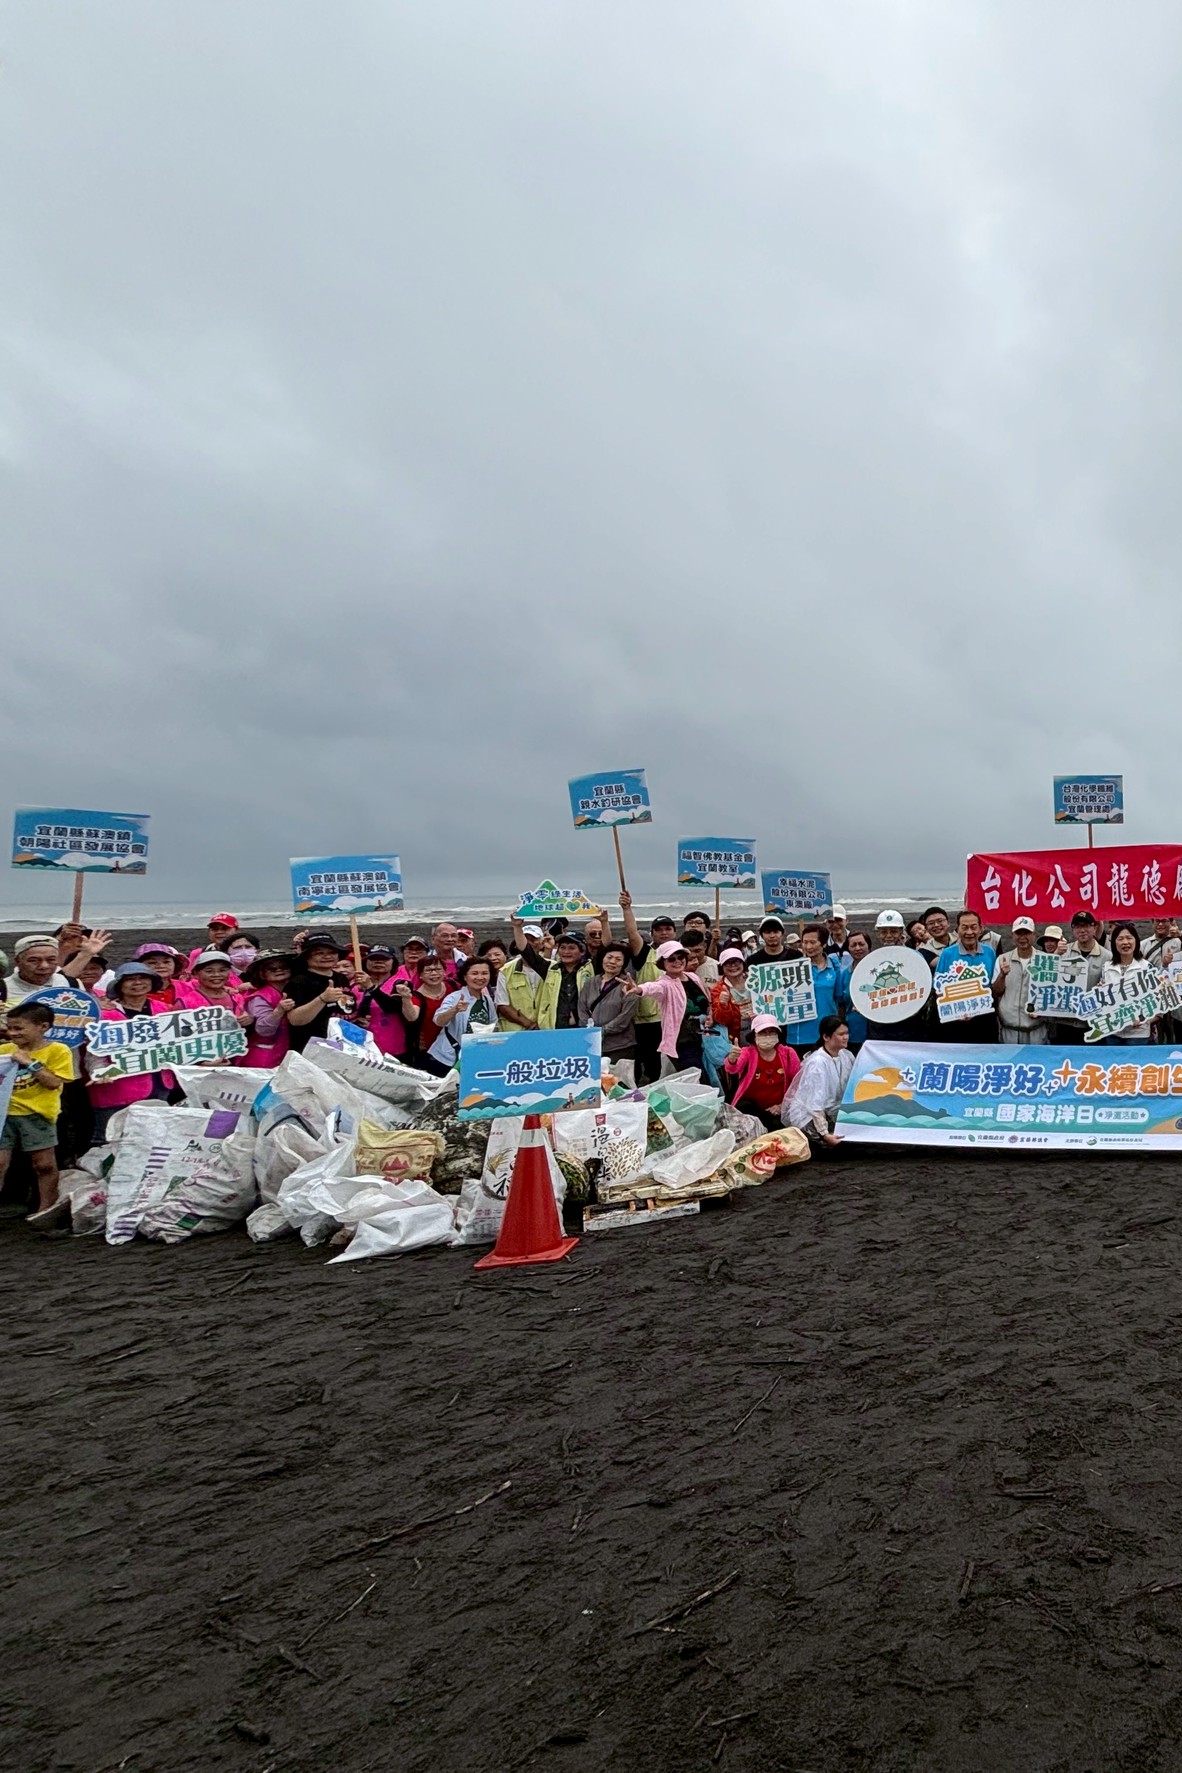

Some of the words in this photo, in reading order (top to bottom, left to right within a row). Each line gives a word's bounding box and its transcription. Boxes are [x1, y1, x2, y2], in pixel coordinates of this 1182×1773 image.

[593, 784, 625, 797] 宜蘭縣
[579, 794, 642, 810] 親水釣研協會
[36, 825, 132, 841] 宜蘭縣蘇澳鎮
[19, 836, 146, 854] 朝陽社區發展協會
[682, 851, 754, 863] 福智佛教基金會
[697, 863, 739, 873] 宜蘭教室
[310, 871, 387, 885] 宜蘭縣蘇澳鎮
[778, 878, 815, 888] 幸福水泥
[298, 882, 400, 896] 南寧社區發展協會
[771, 888, 826, 900] 股份有限公司
[749, 961, 812, 994] 源頭
[1076, 969, 1160, 1018] 海好有你
[940, 996, 991, 1017] 蘭陽淨好
[88, 1007, 223, 1049] 海廢不留
[114, 1031, 247, 1074] 宜蘭更優
[477, 1057, 590, 1084] 一般垃圾
[918, 1062, 1045, 1094] 蘭陽淨好
[996, 1103, 1094, 1123] 國家海洋日
